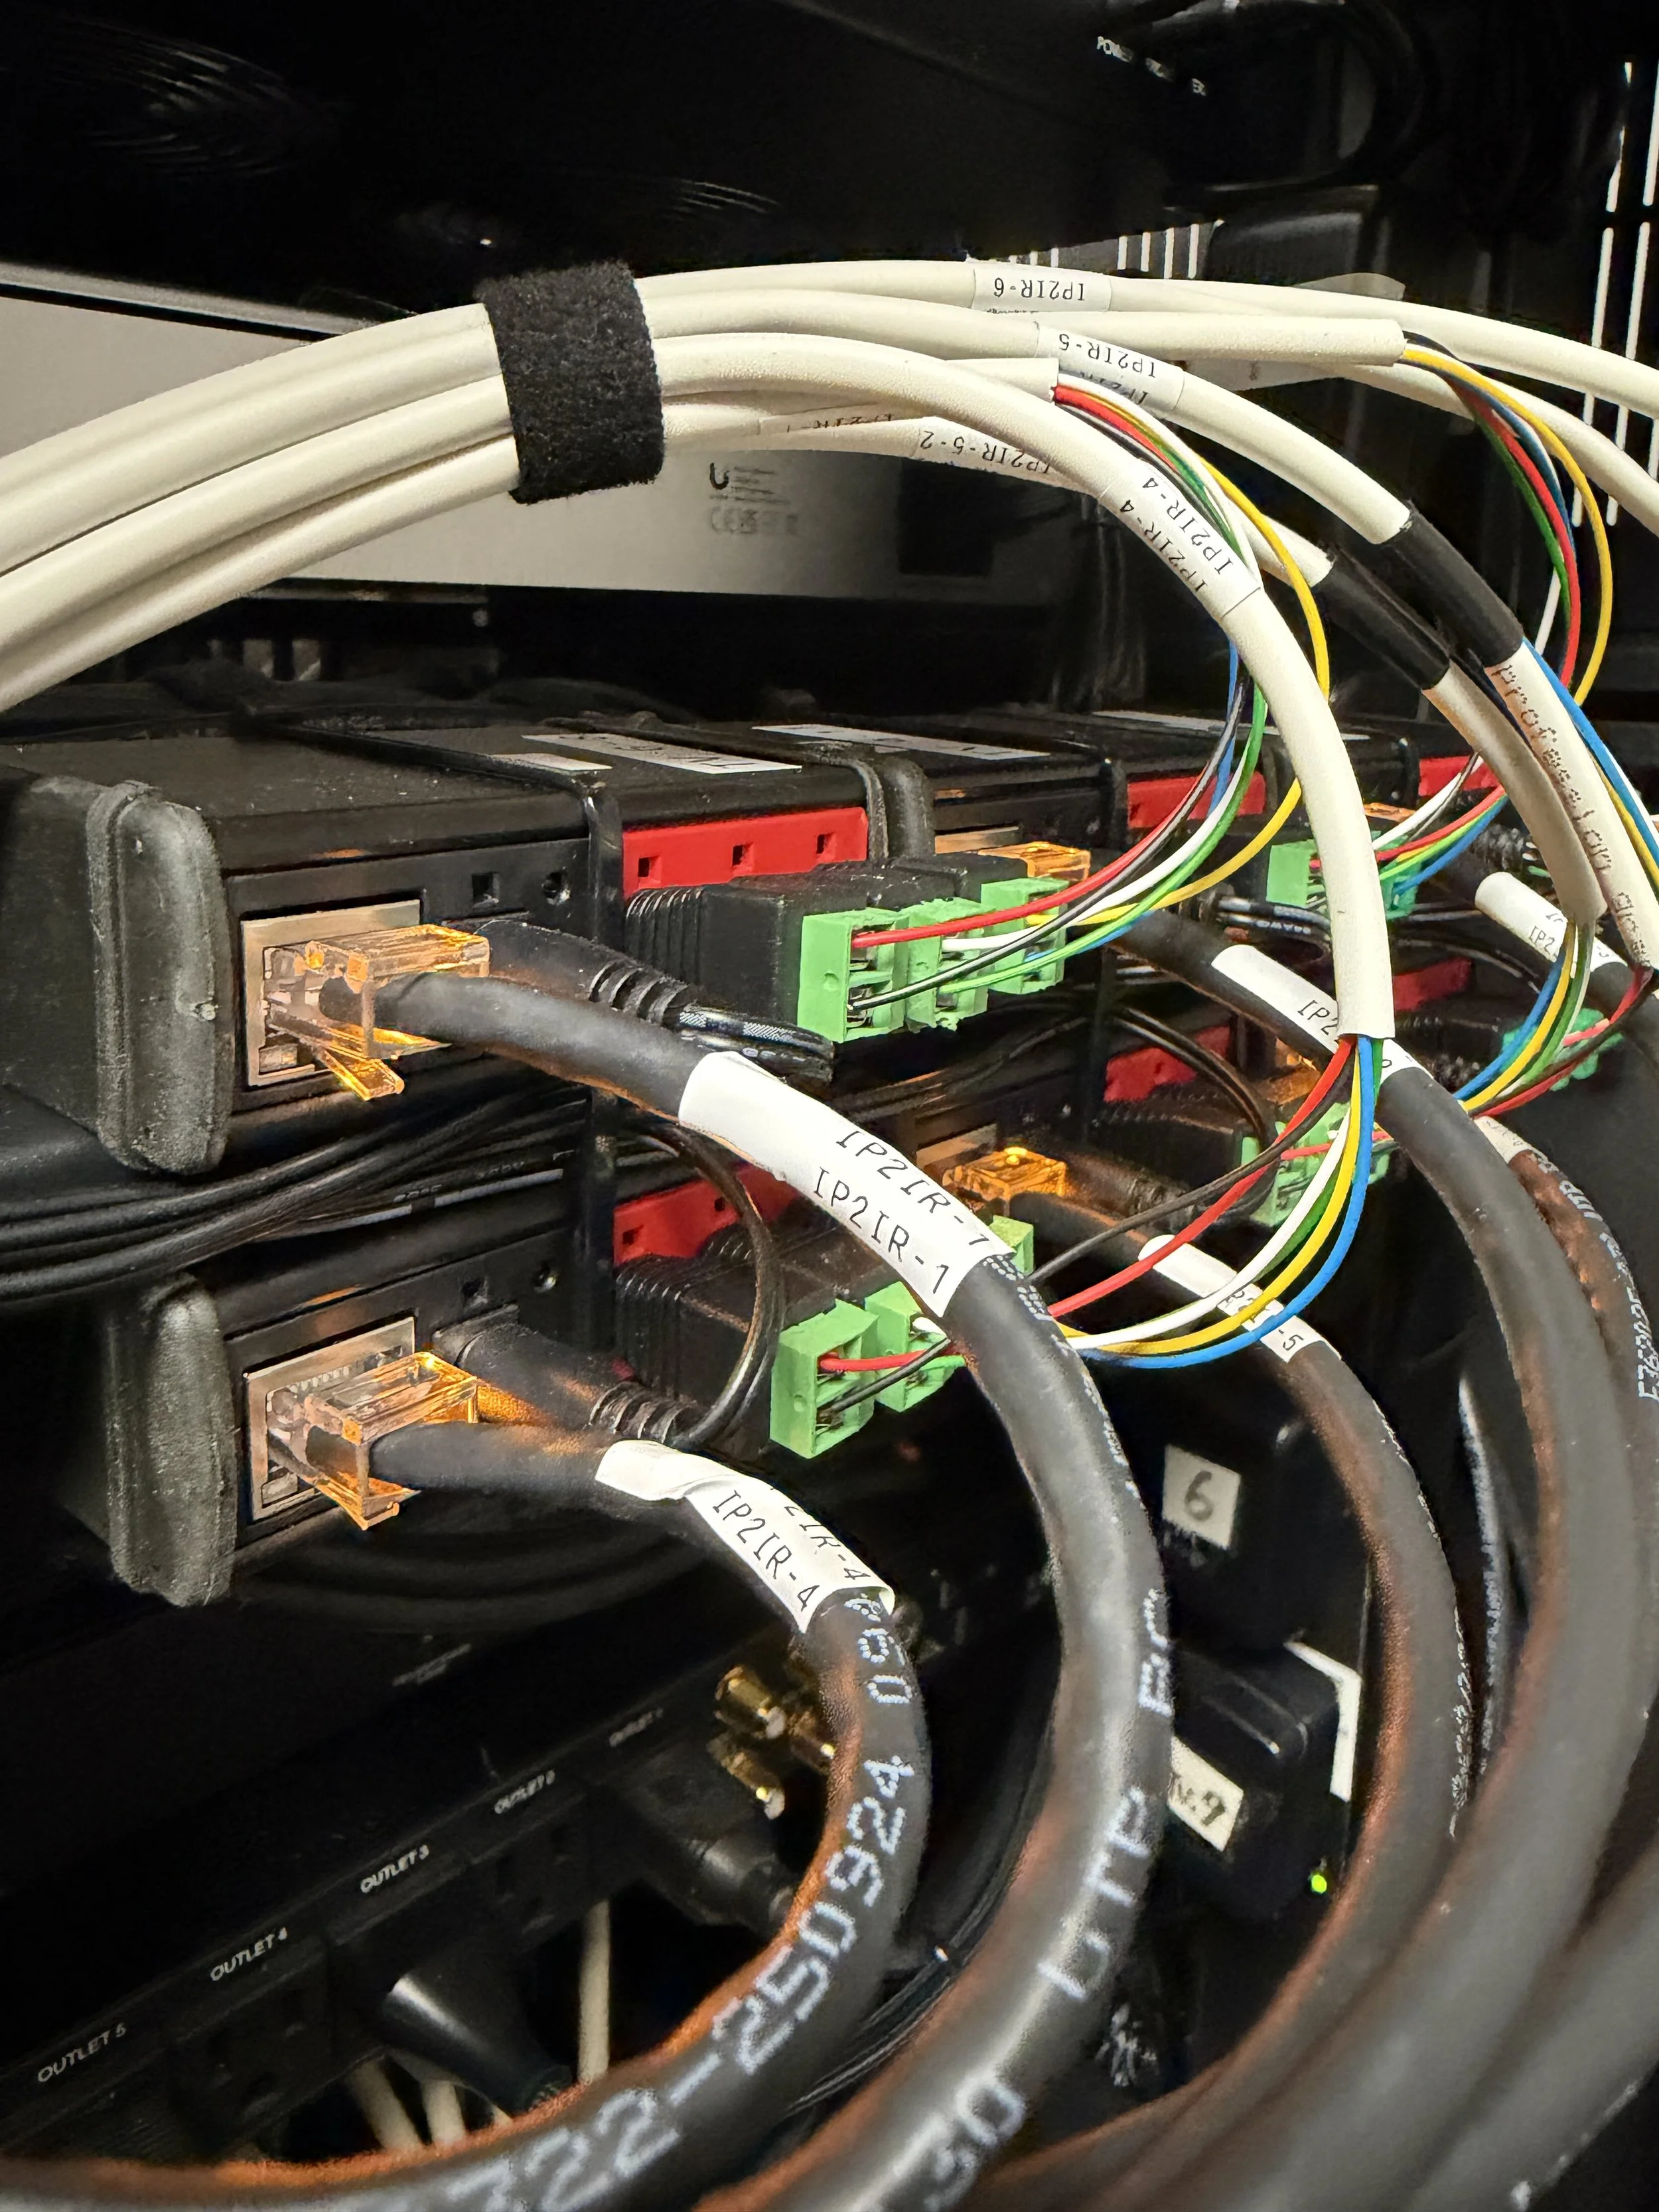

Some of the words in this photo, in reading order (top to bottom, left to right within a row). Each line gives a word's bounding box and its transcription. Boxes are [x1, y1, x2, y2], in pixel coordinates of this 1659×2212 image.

[994, 277, 1086, 301] IP2IR-6
[1058, 333, 1156, 378] IP2IR-5
[1120, 499, 1208, 592] IP2IR-4
[1142, 477, 1233, 575] IP2IR-4
[836, 1130, 990, 1246] IP2IR-1
[812, 1166, 950, 1295] IP2IR-1
[1184, 1470, 1214, 1520] 6
[713, 1489, 820, 1613] IP2IR-4
[360, 1848, 417, 1893] OUTLET
[210, 1933, 275, 1982] OUTLET
[37, 2029, 111, 2083] OUTLET
[115, 2022, 127, 2038] 5
